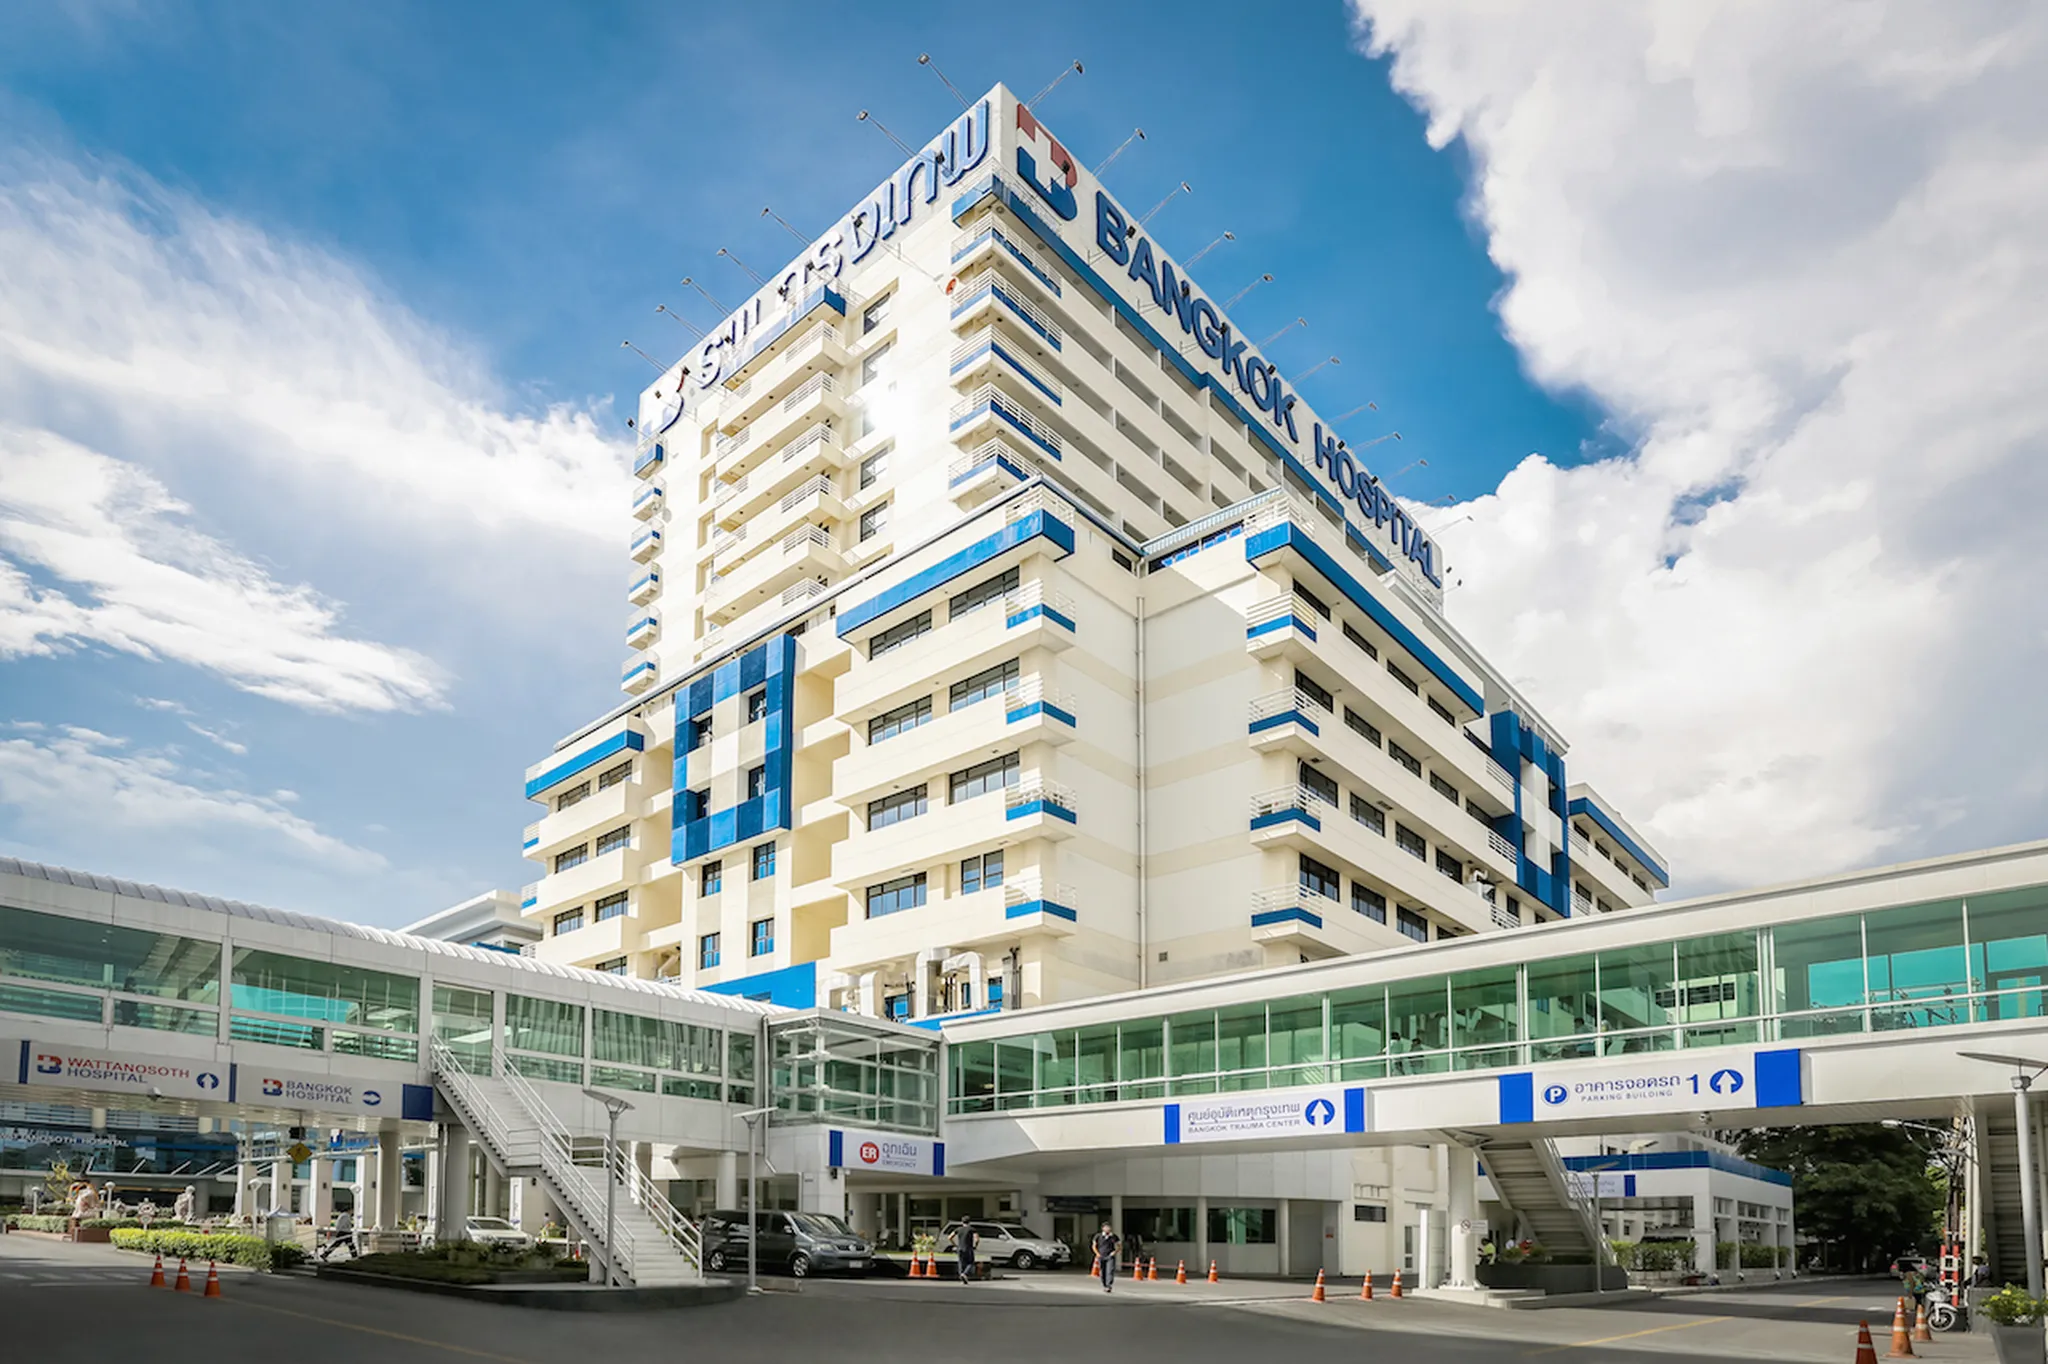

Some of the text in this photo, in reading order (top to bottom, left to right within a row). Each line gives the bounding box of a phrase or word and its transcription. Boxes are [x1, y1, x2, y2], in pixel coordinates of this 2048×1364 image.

[1095, 190, 1300, 444] BANGKOK
[1314, 422, 1442, 589] HOSPITAL
[67, 1057, 190, 1079] WATTANOSOTH
[67, 1067, 148, 1084] HOSPITAL
[286, 1080, 352, 1096] BANGKOK
[1575, 1075, 1681, 1094] อาคารจอดรถ
[1686, 1073, 1699, 1095] 1
[286, 1090, 352, 1104] HOSPITAL
[1581, 1090, 1673, 1102] PARKING BUILDING
[1187, 1102, 1301, 1125] ศูนย์อุบัติเหตุกรุงเทพ
[1188, 1119, 1300, 1134] BANGKOK TRAUMA CENTER
[861, 1146, 878, 1159] ER
[882, 1142, 917, 1158] ฉุกเฉิน
